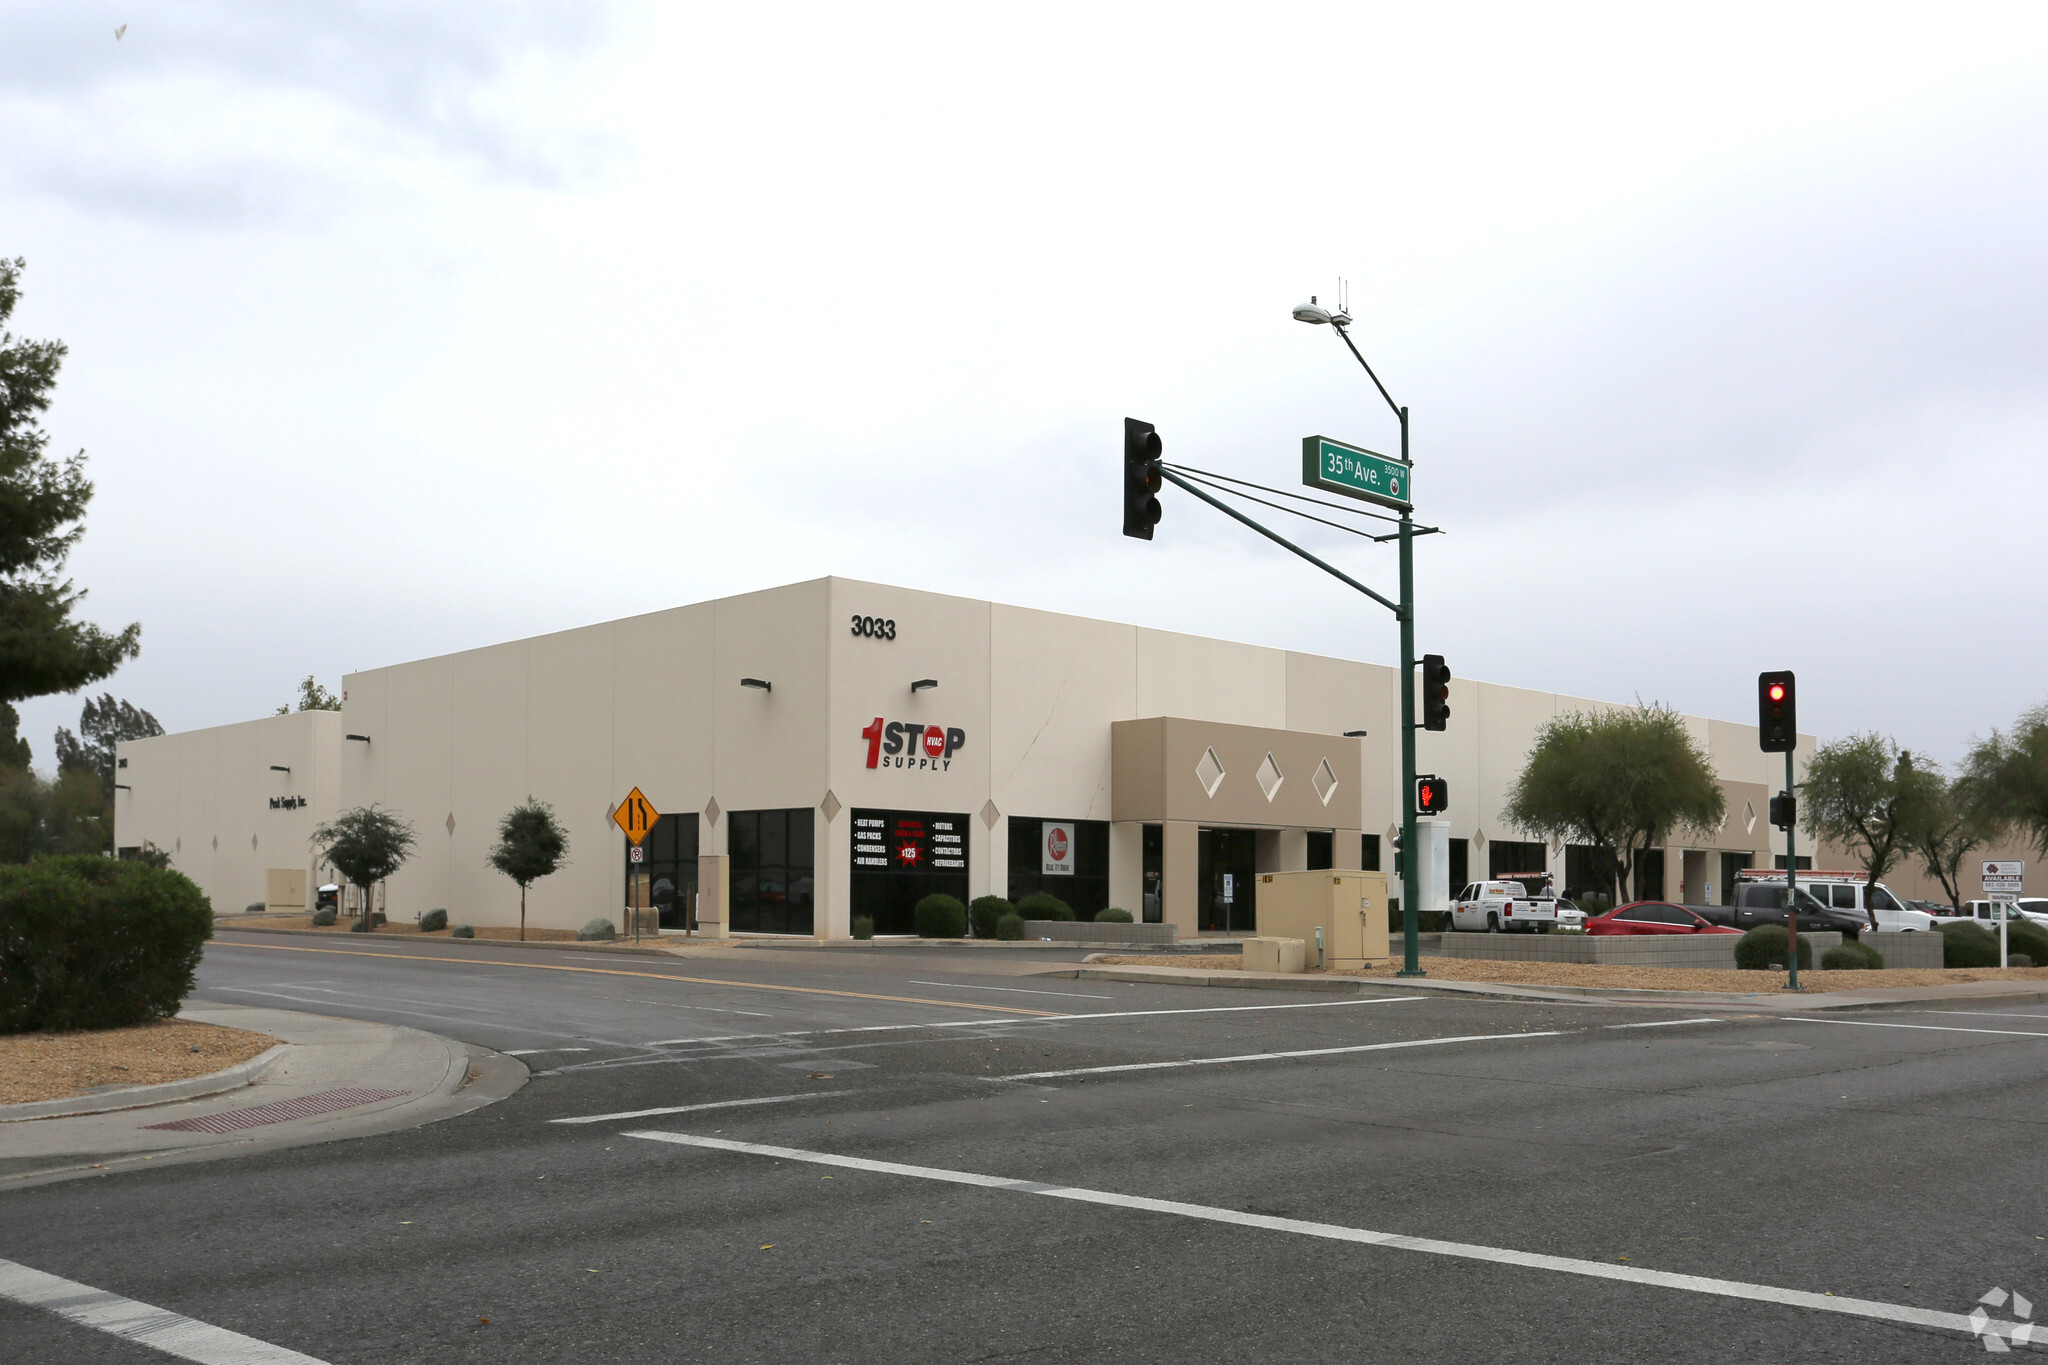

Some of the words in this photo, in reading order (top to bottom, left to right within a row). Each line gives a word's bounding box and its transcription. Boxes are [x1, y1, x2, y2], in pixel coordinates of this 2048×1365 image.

[1328, 452, 1353, 475] 35th
[1354, 461, 1381, 486] Ave.
[1384, 464, 1399, 477] 3500
[1400, 469, 1405, 478] W
[851, 614, 896, 641] 3033
[926, 736, 942, 747] HVAC
[883, 756, 951, 771] SUPPLY
[857, 819, 868, 827] HEAT
[869, 819, 885, 828] PUMPS
[935, 822, 953, 830] MOTORS
[857, 831, 866, 840] GAS
[867, 832, 882, 840] PACKS
[935, 834, 961, 843] CAPACITORS
[857, 844, 886, 853] CONDENSERS
[1050, 833, 1068, 857] Rheem
[902, 847, 916, 858] $125
[935, 847, 962, 856] CONTACTORS
[857, 857, 865, 865] AIR
[865, 857, 888, 866] HANDLERS
[935, 859, 965, 868] REFRIGERANTS
